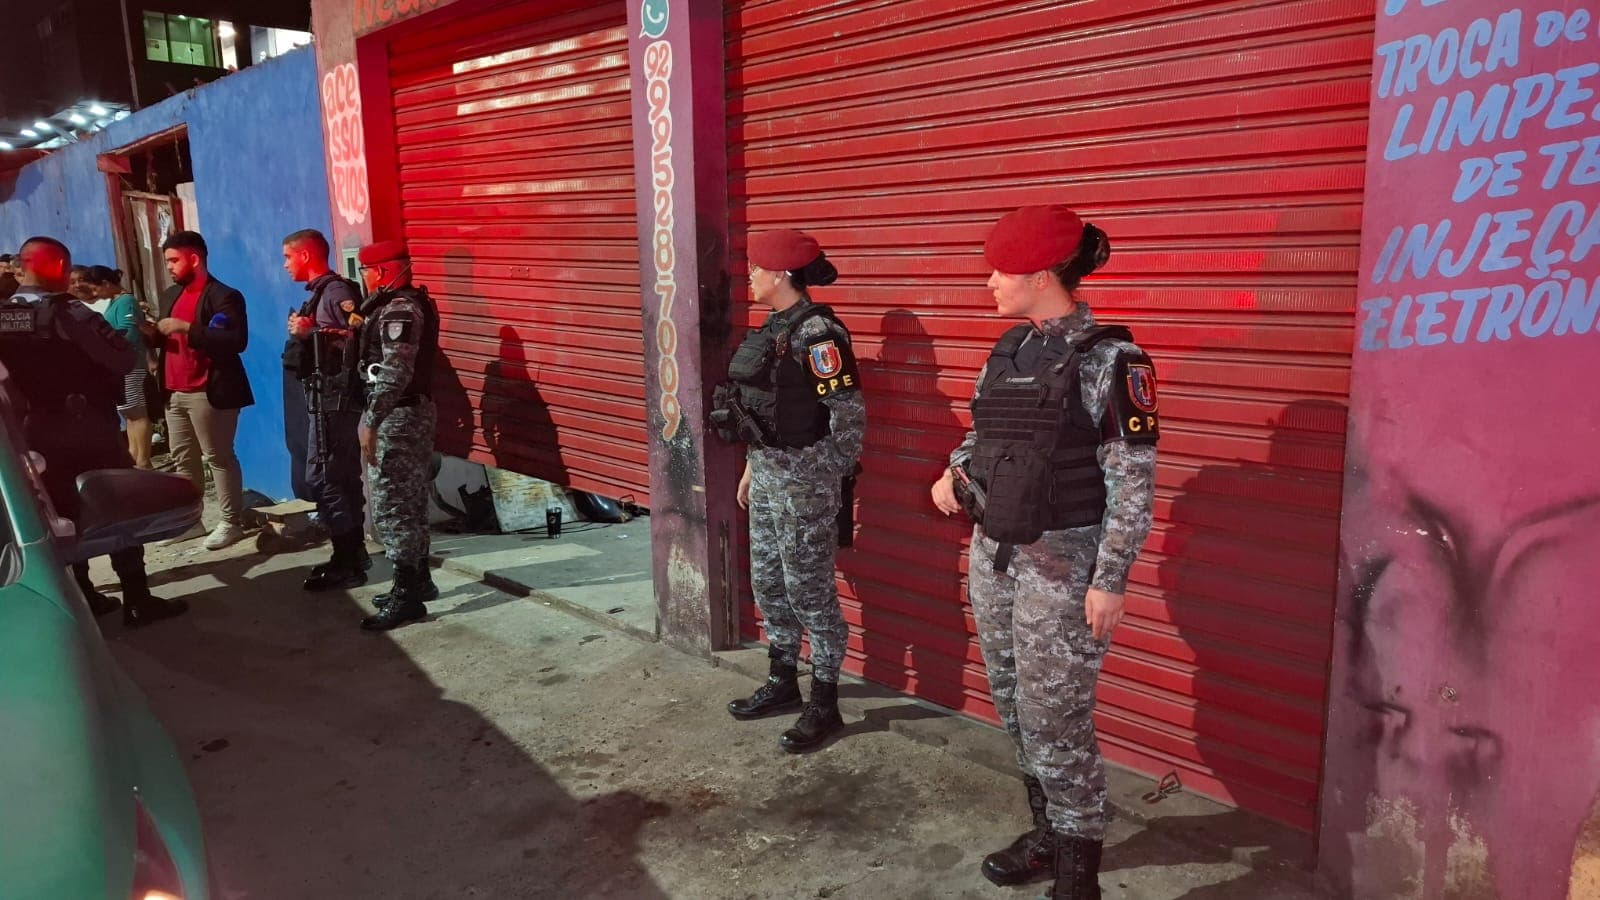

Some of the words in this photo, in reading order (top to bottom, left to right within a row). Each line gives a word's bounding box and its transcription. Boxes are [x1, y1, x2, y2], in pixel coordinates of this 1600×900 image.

[1376, 8, 1522, 99] TROCA
[1383, 62, 1600, 161] LIMPE
[1452, 150, 1527, 203] DE
[1359, 268, 1600, 352] ELETRÔN
